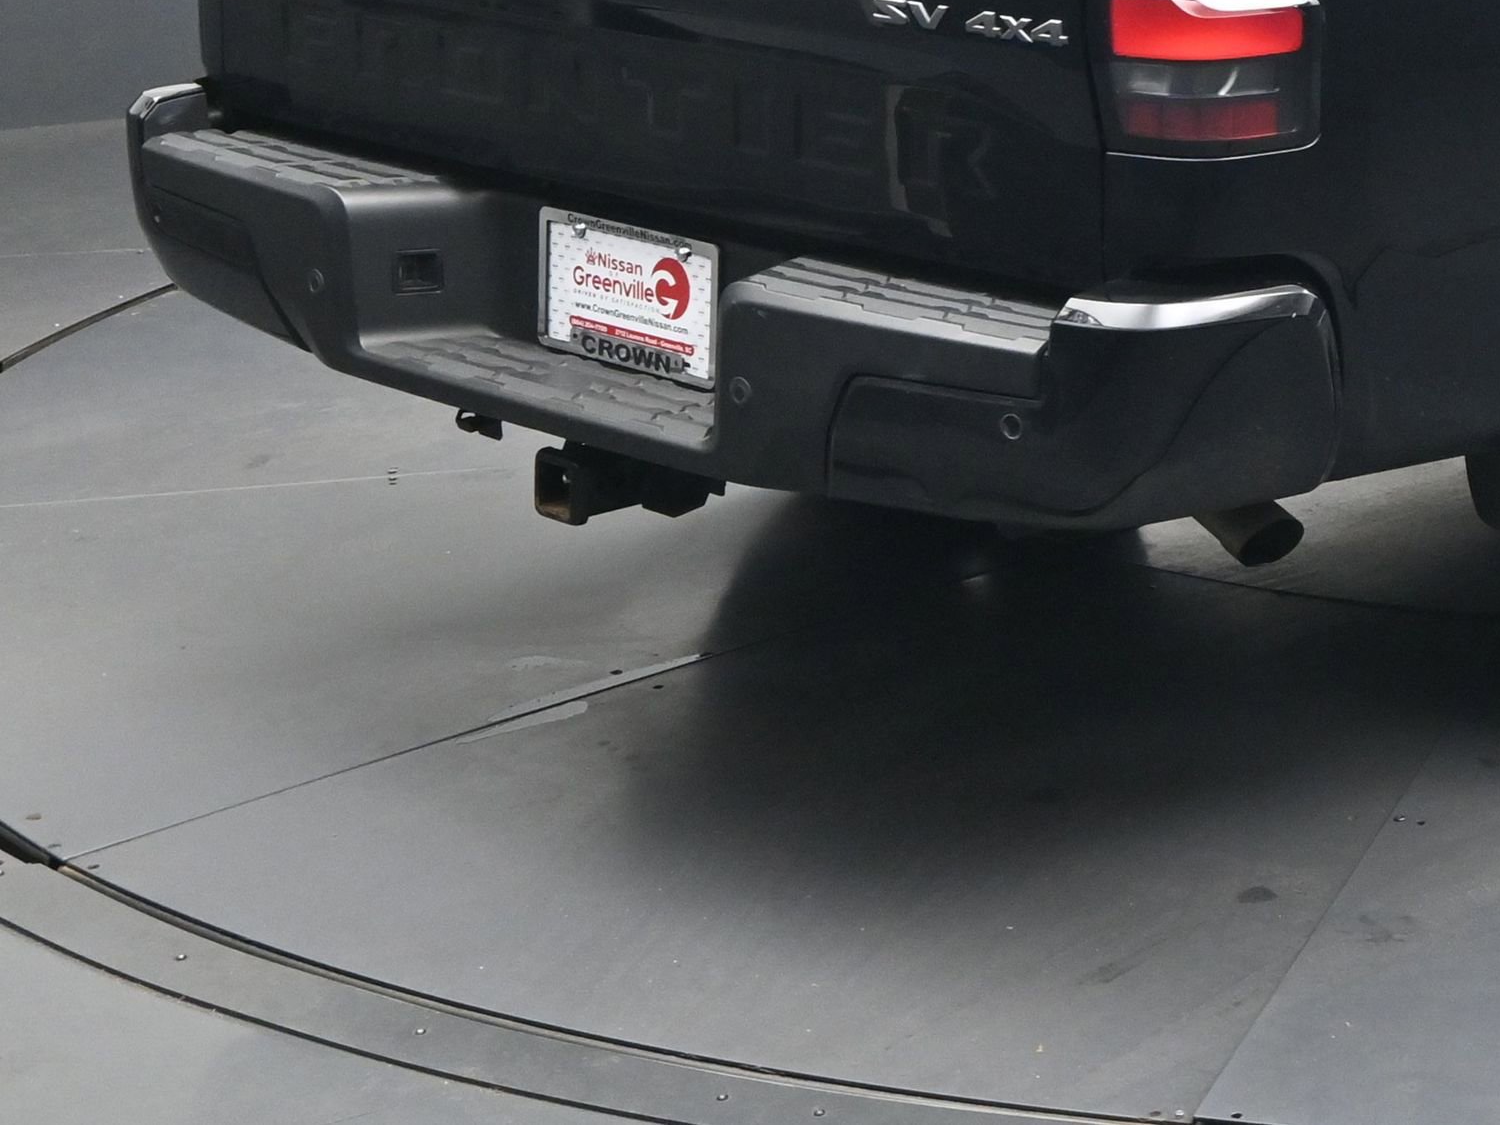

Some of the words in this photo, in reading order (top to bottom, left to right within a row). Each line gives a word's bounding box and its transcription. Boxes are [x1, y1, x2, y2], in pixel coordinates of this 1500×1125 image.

[598, 252, 643, 276] Nissan
[573, 266, 654, 303] Greenville
[575, 302, 689, 335] www.CrownGreenvilleNissan.com
[581, 334, 671, 374] CROWN
